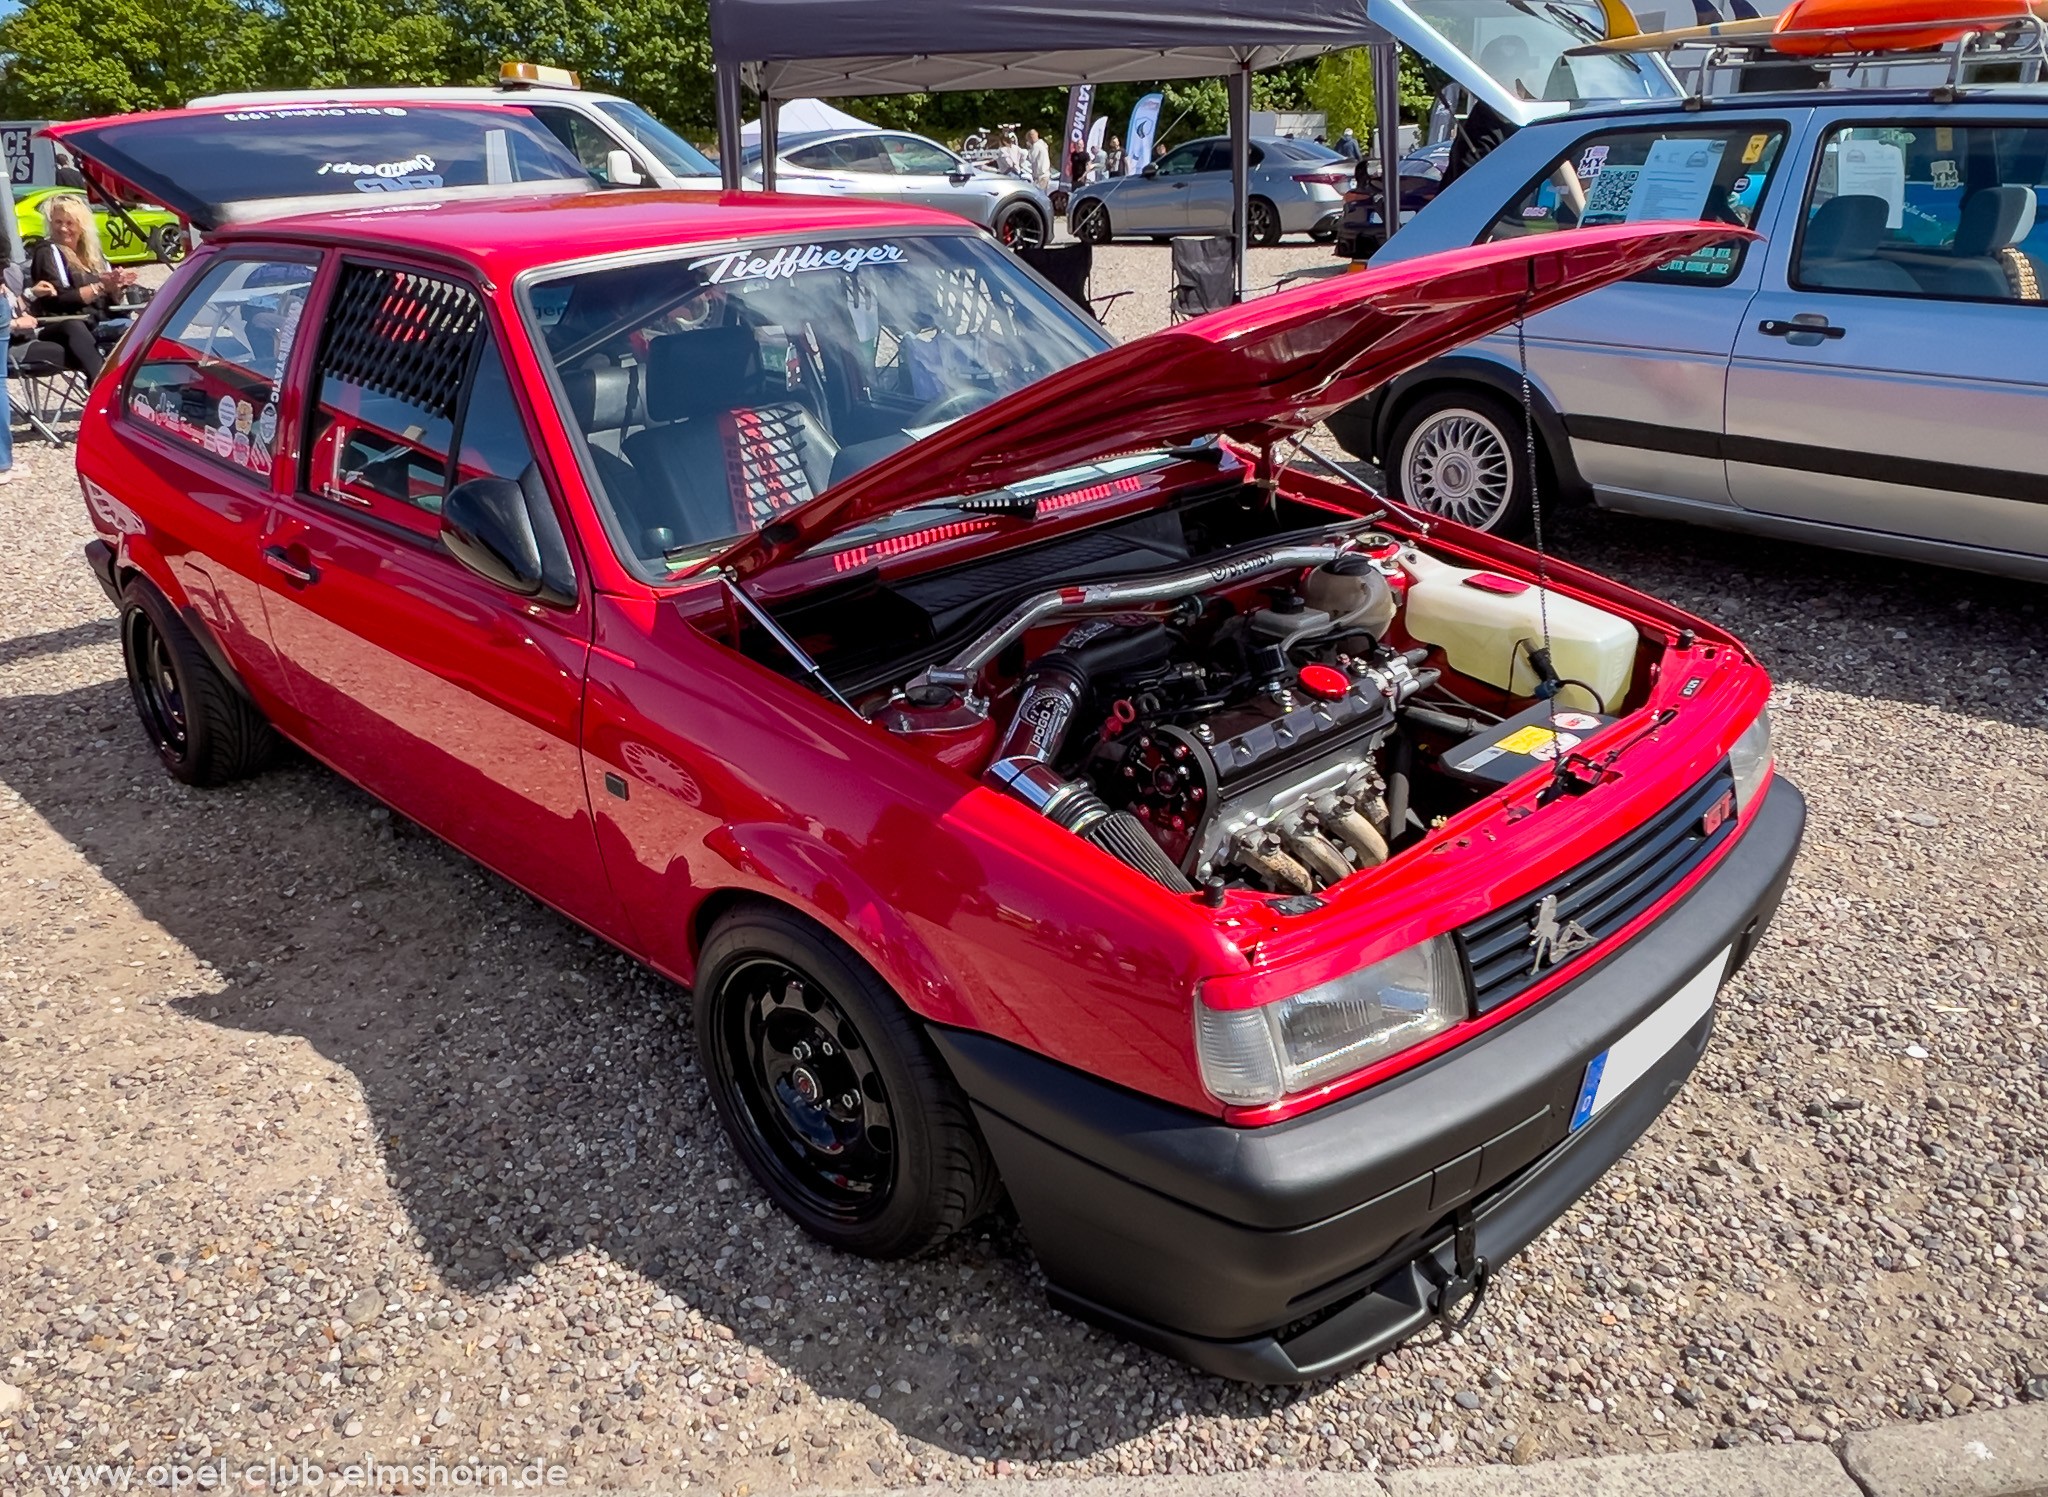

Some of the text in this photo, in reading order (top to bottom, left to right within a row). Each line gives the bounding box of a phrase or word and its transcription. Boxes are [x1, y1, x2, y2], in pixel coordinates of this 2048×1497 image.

[1578, 168, 1600, 176] CAR
[1580, 157, 1604, 169] MY
[688, 244, 905, 285] Tiefflieger
[1032, 709, 1051, 745] POGO
[1703, 789, 1734, 837] GT
